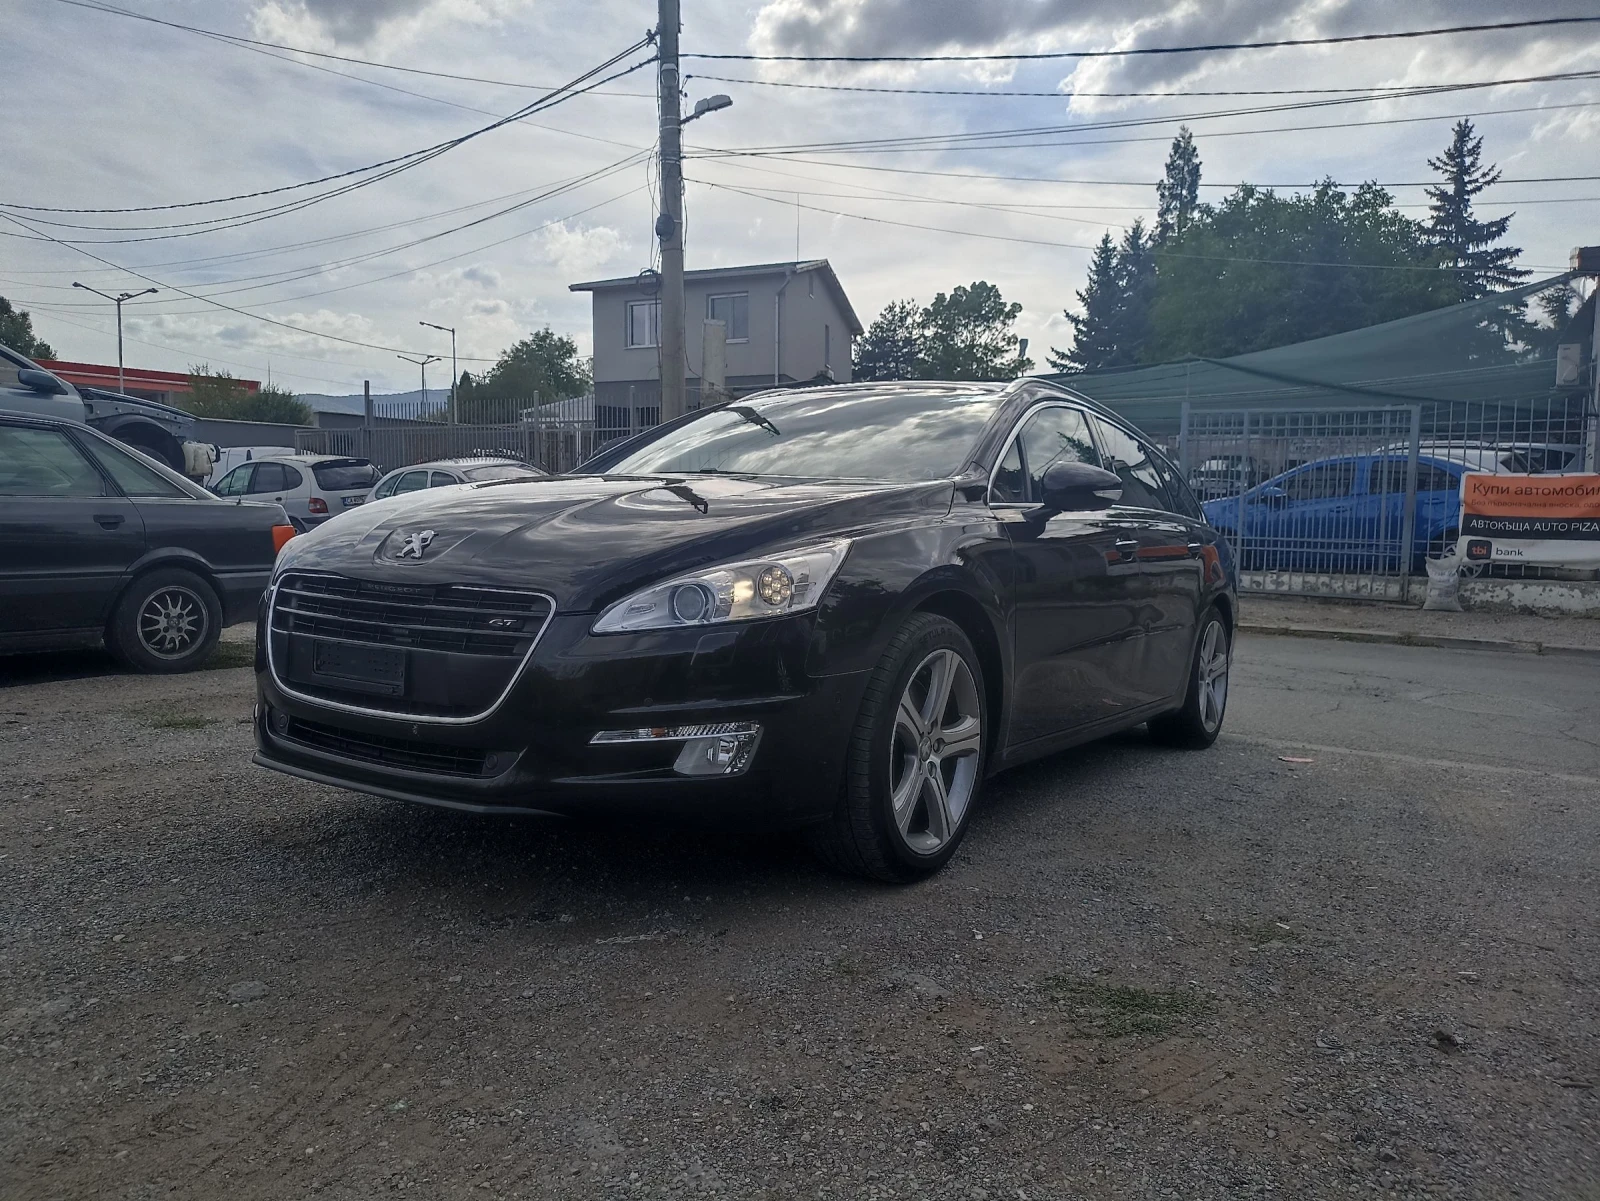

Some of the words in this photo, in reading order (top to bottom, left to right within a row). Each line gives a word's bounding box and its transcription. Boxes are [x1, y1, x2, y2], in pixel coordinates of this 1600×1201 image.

[1473, 483, 1511, 497] Купи
[1470, 519, 1531, 532] АВТОКЪЩА
[1534, 522, 1569, 532] AUTO
[1571, 522, 1600, 532] PIZA
[1472, 546, 1487, 555] tbi
[1495, 546, 1524, 557] bank
[488, 618, 518, 626] GT
